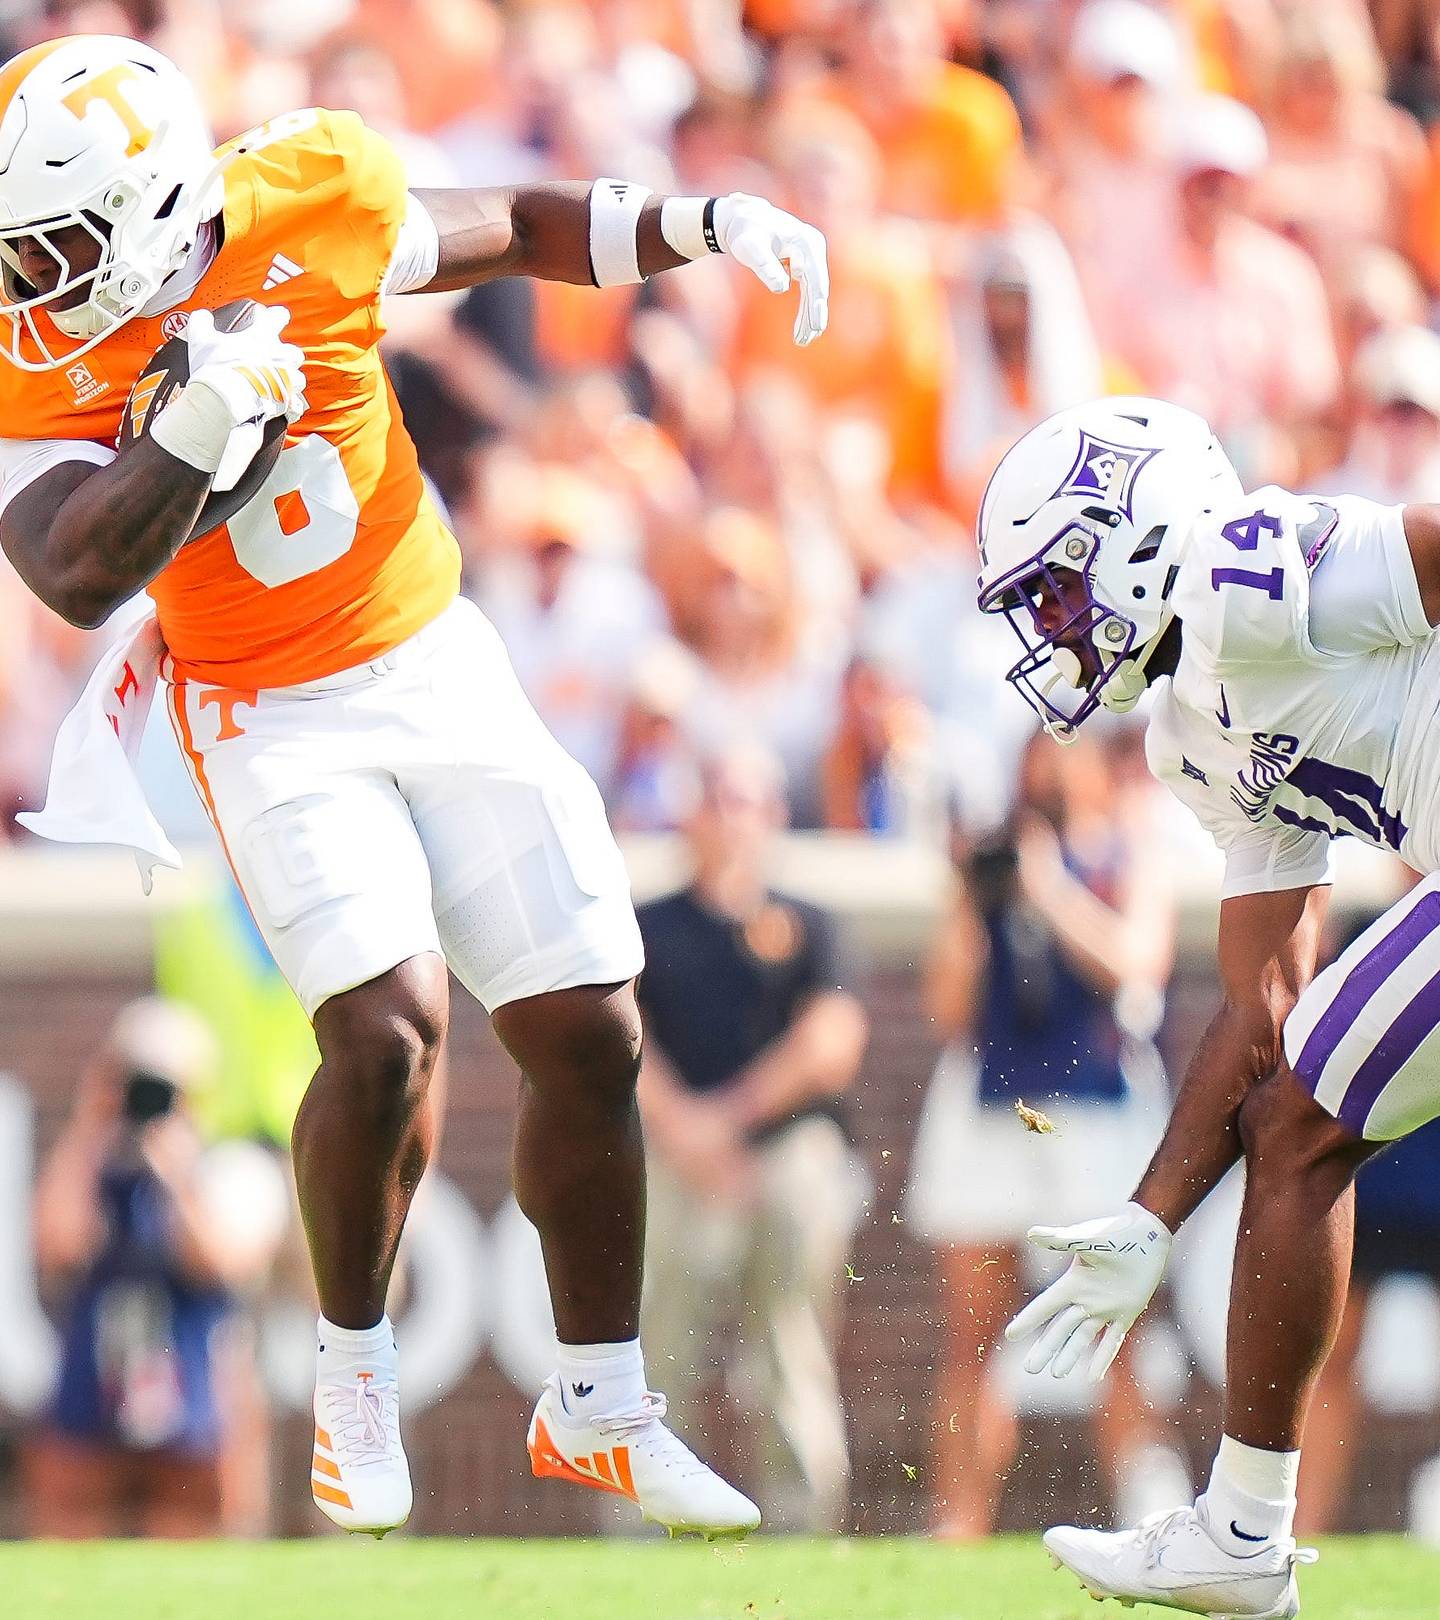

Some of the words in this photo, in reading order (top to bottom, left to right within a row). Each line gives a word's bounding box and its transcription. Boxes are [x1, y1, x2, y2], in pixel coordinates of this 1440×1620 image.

[60, 64, 154, 159] T
[1212, 508, 1284, 601] 14
[199, 689, 258, 742] T
